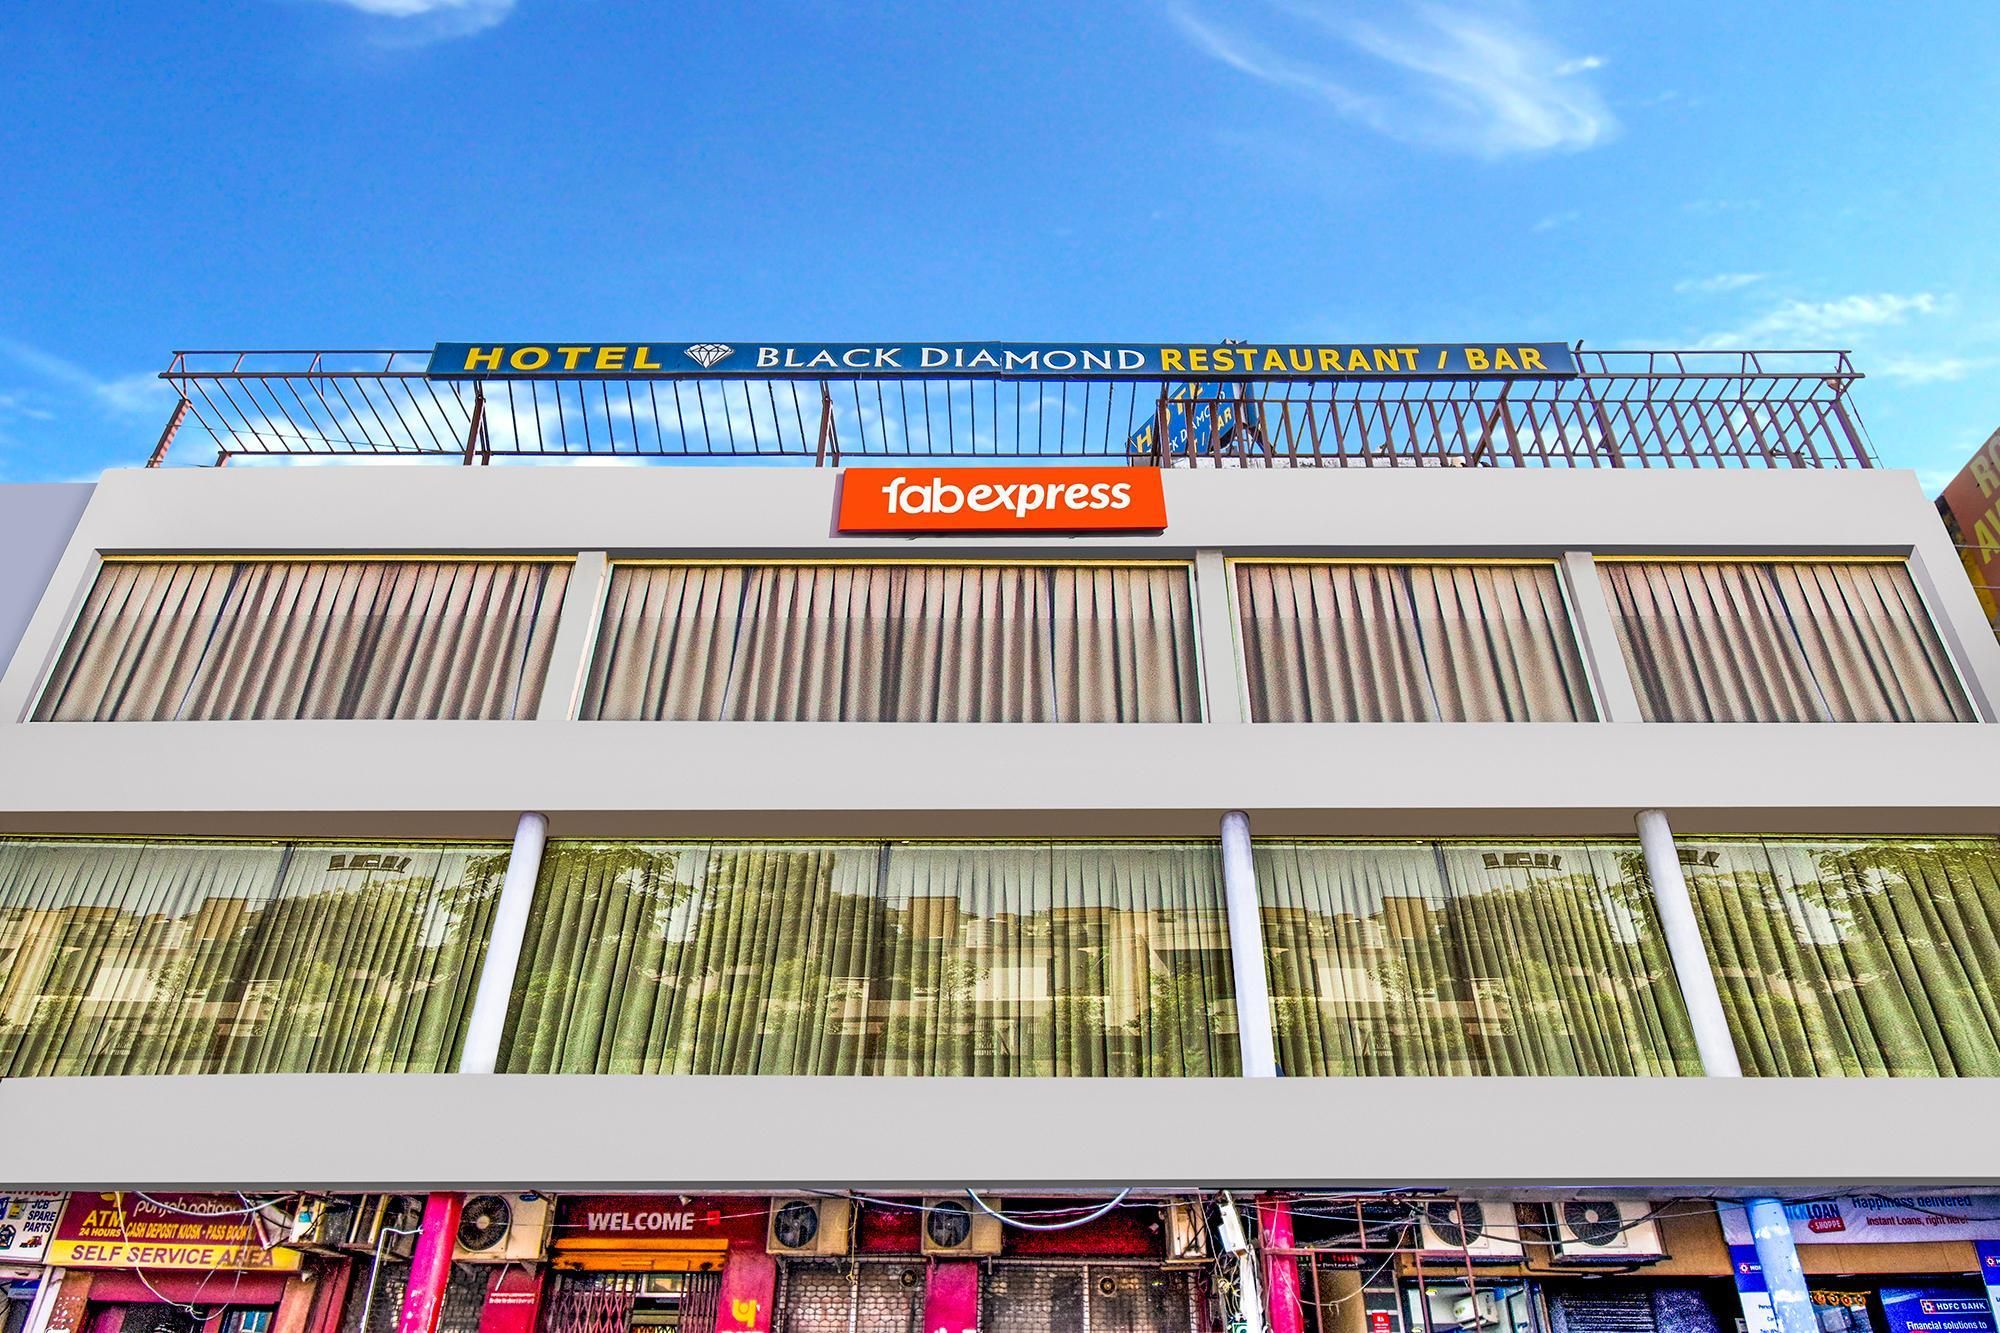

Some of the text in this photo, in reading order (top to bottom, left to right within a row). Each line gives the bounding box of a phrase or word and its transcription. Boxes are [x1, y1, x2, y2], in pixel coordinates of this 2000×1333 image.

[463, 347, 1548, 372] HOTEL BLACK DIAMOND RESTAURANT / BAR
[31, 1200, 50, 1210] JCB
[28, 1210, 56, 1222] SPARE
[82, 1210, 127, 1228] ATM
[587, 1212, 695, 1231] WELCOME
[1866, 1215, 1895, 1226] Instant
[1896, 1215, 1925, 1227] Loans,
[1925, 1214, 1946, 1227] right
[23, 1221, 52, 1233] PARTS
[1814, 1219, 1842, 1230] SHOPPE
[79, 1227, 121, 1238] 24 HOURS
[126, 1222, 147, 1238] CASH
[147, 1223, 178, 1239] DEPOSIT
[178, 1224, 202, 1239] KIOSK
[205, 1225, 227, 1240] PASS
[71, 1244, 274, 1267] SELF SERVICE AREA
[1936, 1302, 1986, 1311] HDFC BANK
[1906, 1320, 1988, 1330] Financial solutions to
